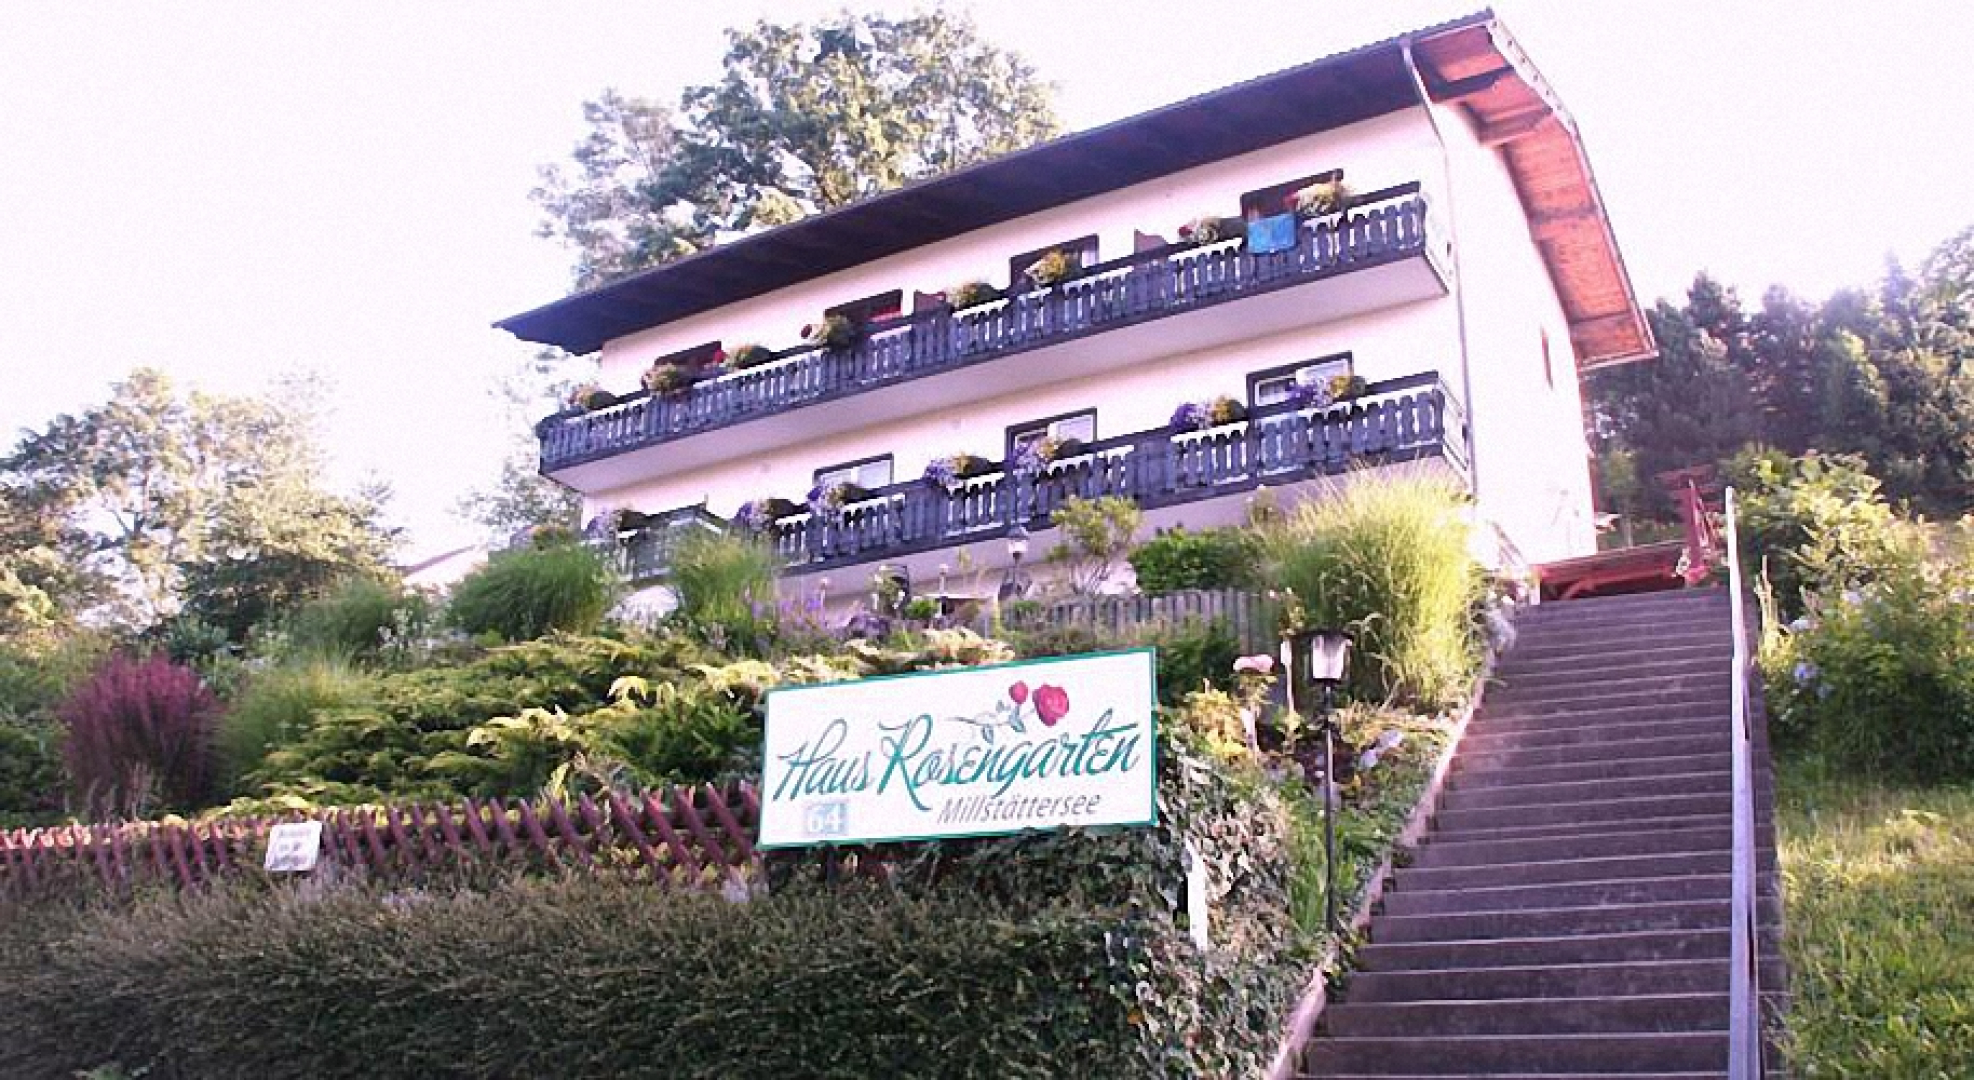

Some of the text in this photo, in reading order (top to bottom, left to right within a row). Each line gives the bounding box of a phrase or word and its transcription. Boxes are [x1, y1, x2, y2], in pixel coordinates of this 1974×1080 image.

[772, 708, 1142, 812] Haus Rosengarten
[806, 804, 844, 834] 64
[937, 791, 1102, 825] Millstättersee
